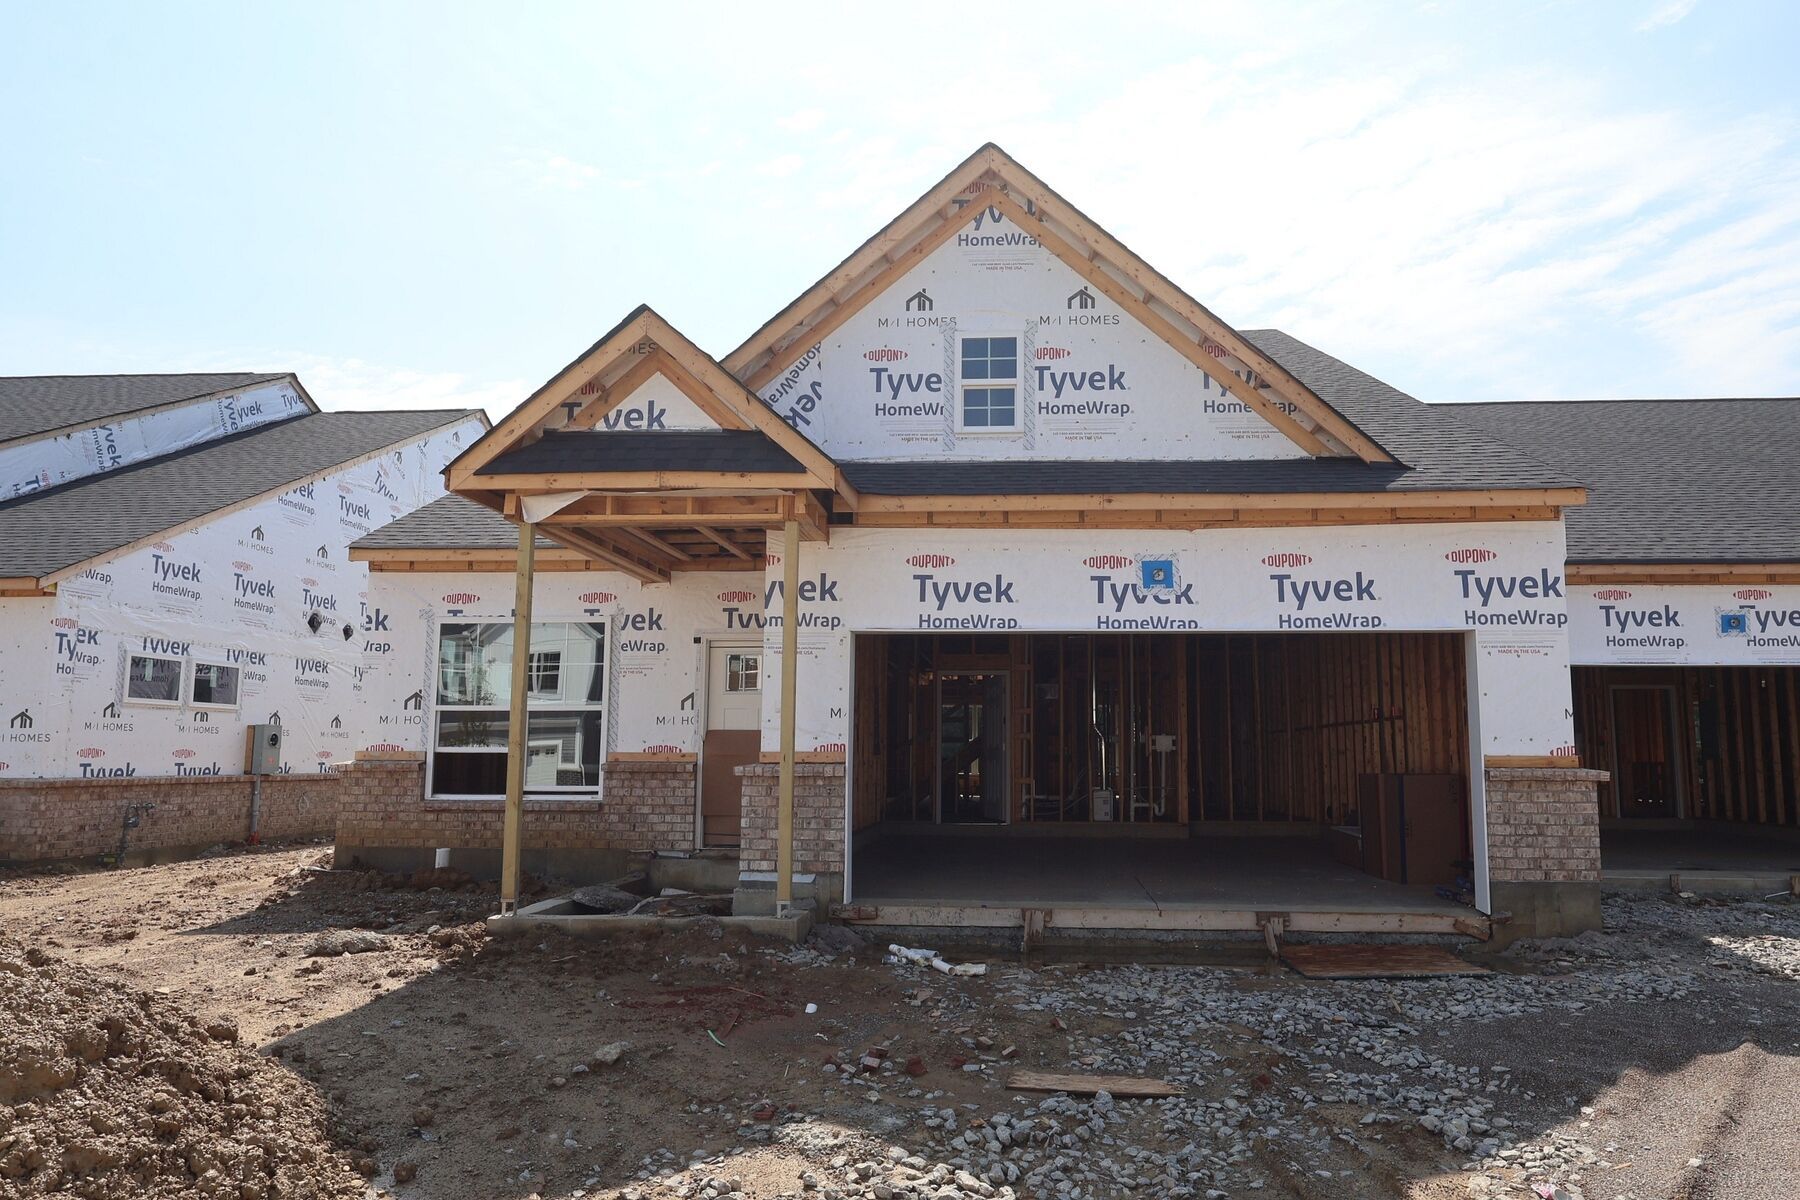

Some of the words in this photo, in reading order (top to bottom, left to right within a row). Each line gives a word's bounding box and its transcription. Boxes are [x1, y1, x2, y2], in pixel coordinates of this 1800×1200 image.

[1069, 314, 1120, 326] HOMES
[868, 349, 903, 362] DUPONT
[1035, 347, 1066, 360] UPONT
[869, 367, 943, 400] Tyve
[1035, 364, 1127, 398] Tyvek
[237, 401, 263, 422] yvek
[783, 381, 822, 428] vek
[875, 403, 944, 416] HomeWr
[1038, 401, 1130, 417] HomeWrap
[560, 400, 666, 430] Tvek
[99, 425, 122, 467] yvek
[278, 495, 315, 515] HomeWrap
[339, 495, 370, 520] Tyvek
[251, 541, 274, 555] HOMES
[912, 555, 950, 568] DUPONT
[1089, 556, 1127, 569] DUPONT
[1268, 554, 1306, 567] DUPONT
[1451, 549, 1491, 563] DUPONT
[152, 554, 200, 583] Tyvek
[152, 581, 200, 601] HomeWrap
[234, 572, 275, 598] Tyvek
[913, 574, 1013, 610] Tyvek
[1270, 572, 1377, 610] Tyvek
[1454, 568, 1561, 607] Tyvek
[303, 588, 337, 611] Tyvek
[447, 593, 476, 604] DUPONT
[583, 592, 613, 603] DUPONT
[722, 591, 752, 602] DUPONT
[1598, 590, 1628, 601] DUPONT
[1737, 589, 1768, 600] DUPONT
[234, 598, 274, 614] HomeWrap
[302, 610, 336, 627] HWrap
[919, 614, 1018, 629] HomeWrap
[1097, 616, 1198, 629] HomeWrap
[1279, 613, 1381, 629] HomeWrap
[1465, 610, 1567, 627] HomeWrap
[1599, 605, 1679, 633] Tyvek
[621, 640, 665, 654] eWrap
[1606, 635, 1684, 649] HomeWrap
[1747, 635, 1800, 647] HomeW
[294, 676, 329, 689] HomeWrap
[103, 723, 134, 731] HOMES
[193, 726, 219, 734] HOMES
[10, 733, 51, 742] HOMES
[80, 749, 102, 759] DUPONT
[175, 749, 194, 758] DUPONT
